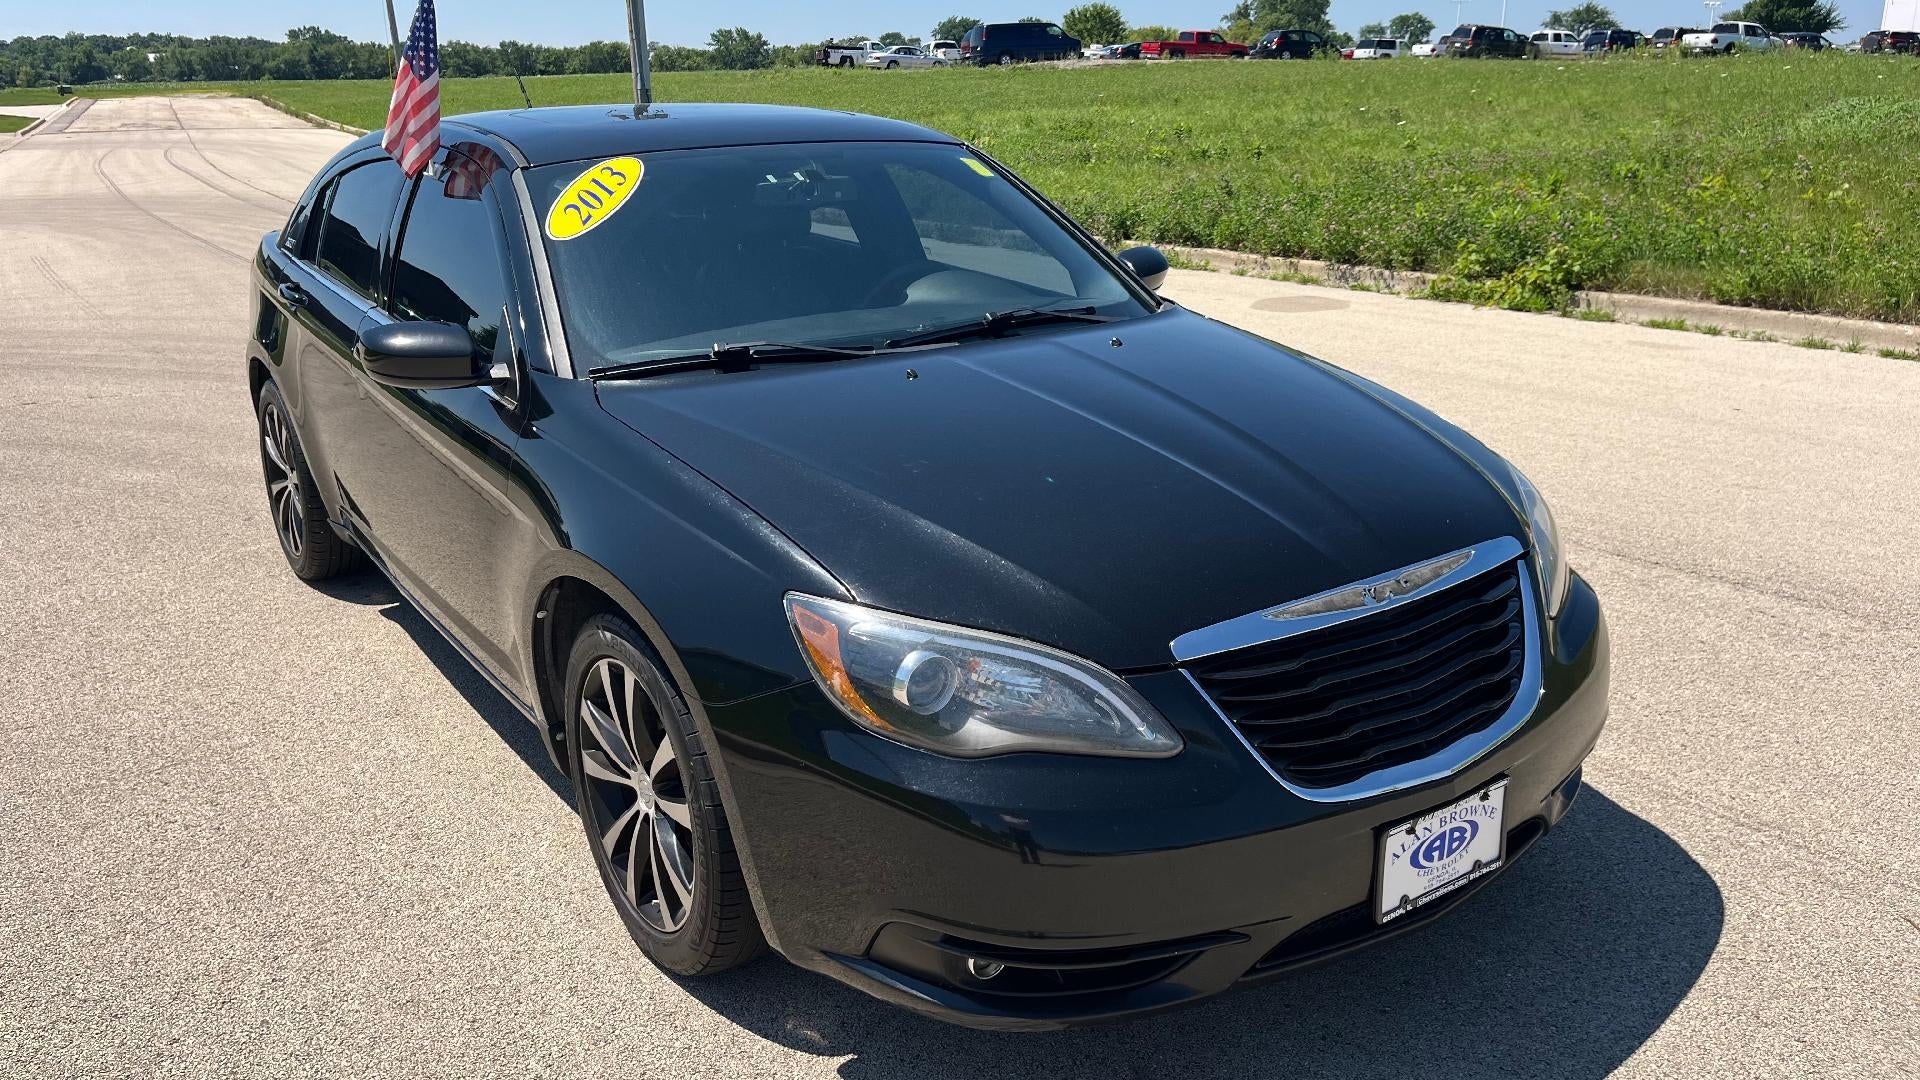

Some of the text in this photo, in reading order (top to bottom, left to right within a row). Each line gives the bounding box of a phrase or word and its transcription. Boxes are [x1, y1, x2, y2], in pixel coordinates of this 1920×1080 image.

[564, 166, 627, 226] 2013
[1391, 822, 1433, 866] ALAN
[1439, 804, 1498, 828] BROWNE
[1422, 826, 1468, 863] AB
[1417, 848, 1471, 877] CHEVROLET
